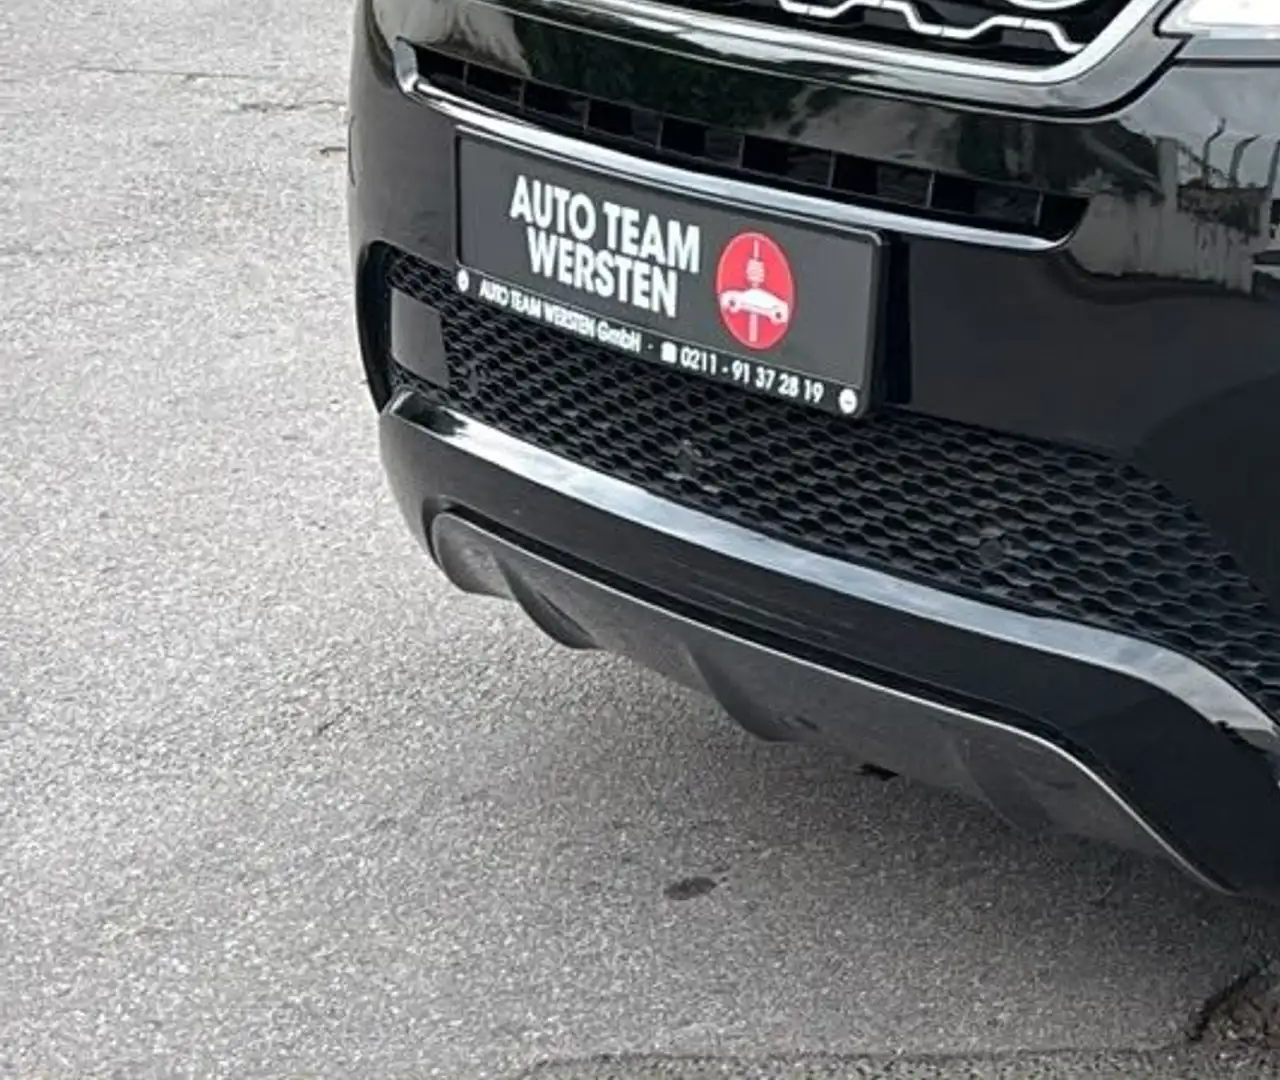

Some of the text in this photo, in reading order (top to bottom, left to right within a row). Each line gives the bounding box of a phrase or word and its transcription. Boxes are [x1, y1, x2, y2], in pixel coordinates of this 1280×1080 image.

[509, 174, 700, 274] AUTO TEAM
[526, 225, 679, 318] WERSTEN
[478, 278, 510, 307] AUTO
[510, 289, 543, 319] TEAM
[543, 301, 598, 338] WERSTEN
[598, 320, 643, 354] GmbH
[680, 346, 717, 375] 0211
[731, 360, 750, 384] 91
[755, 366, 777, 391] 37
[778, 373, 799, 398] 28
[803, 379, 825, 404] 19
